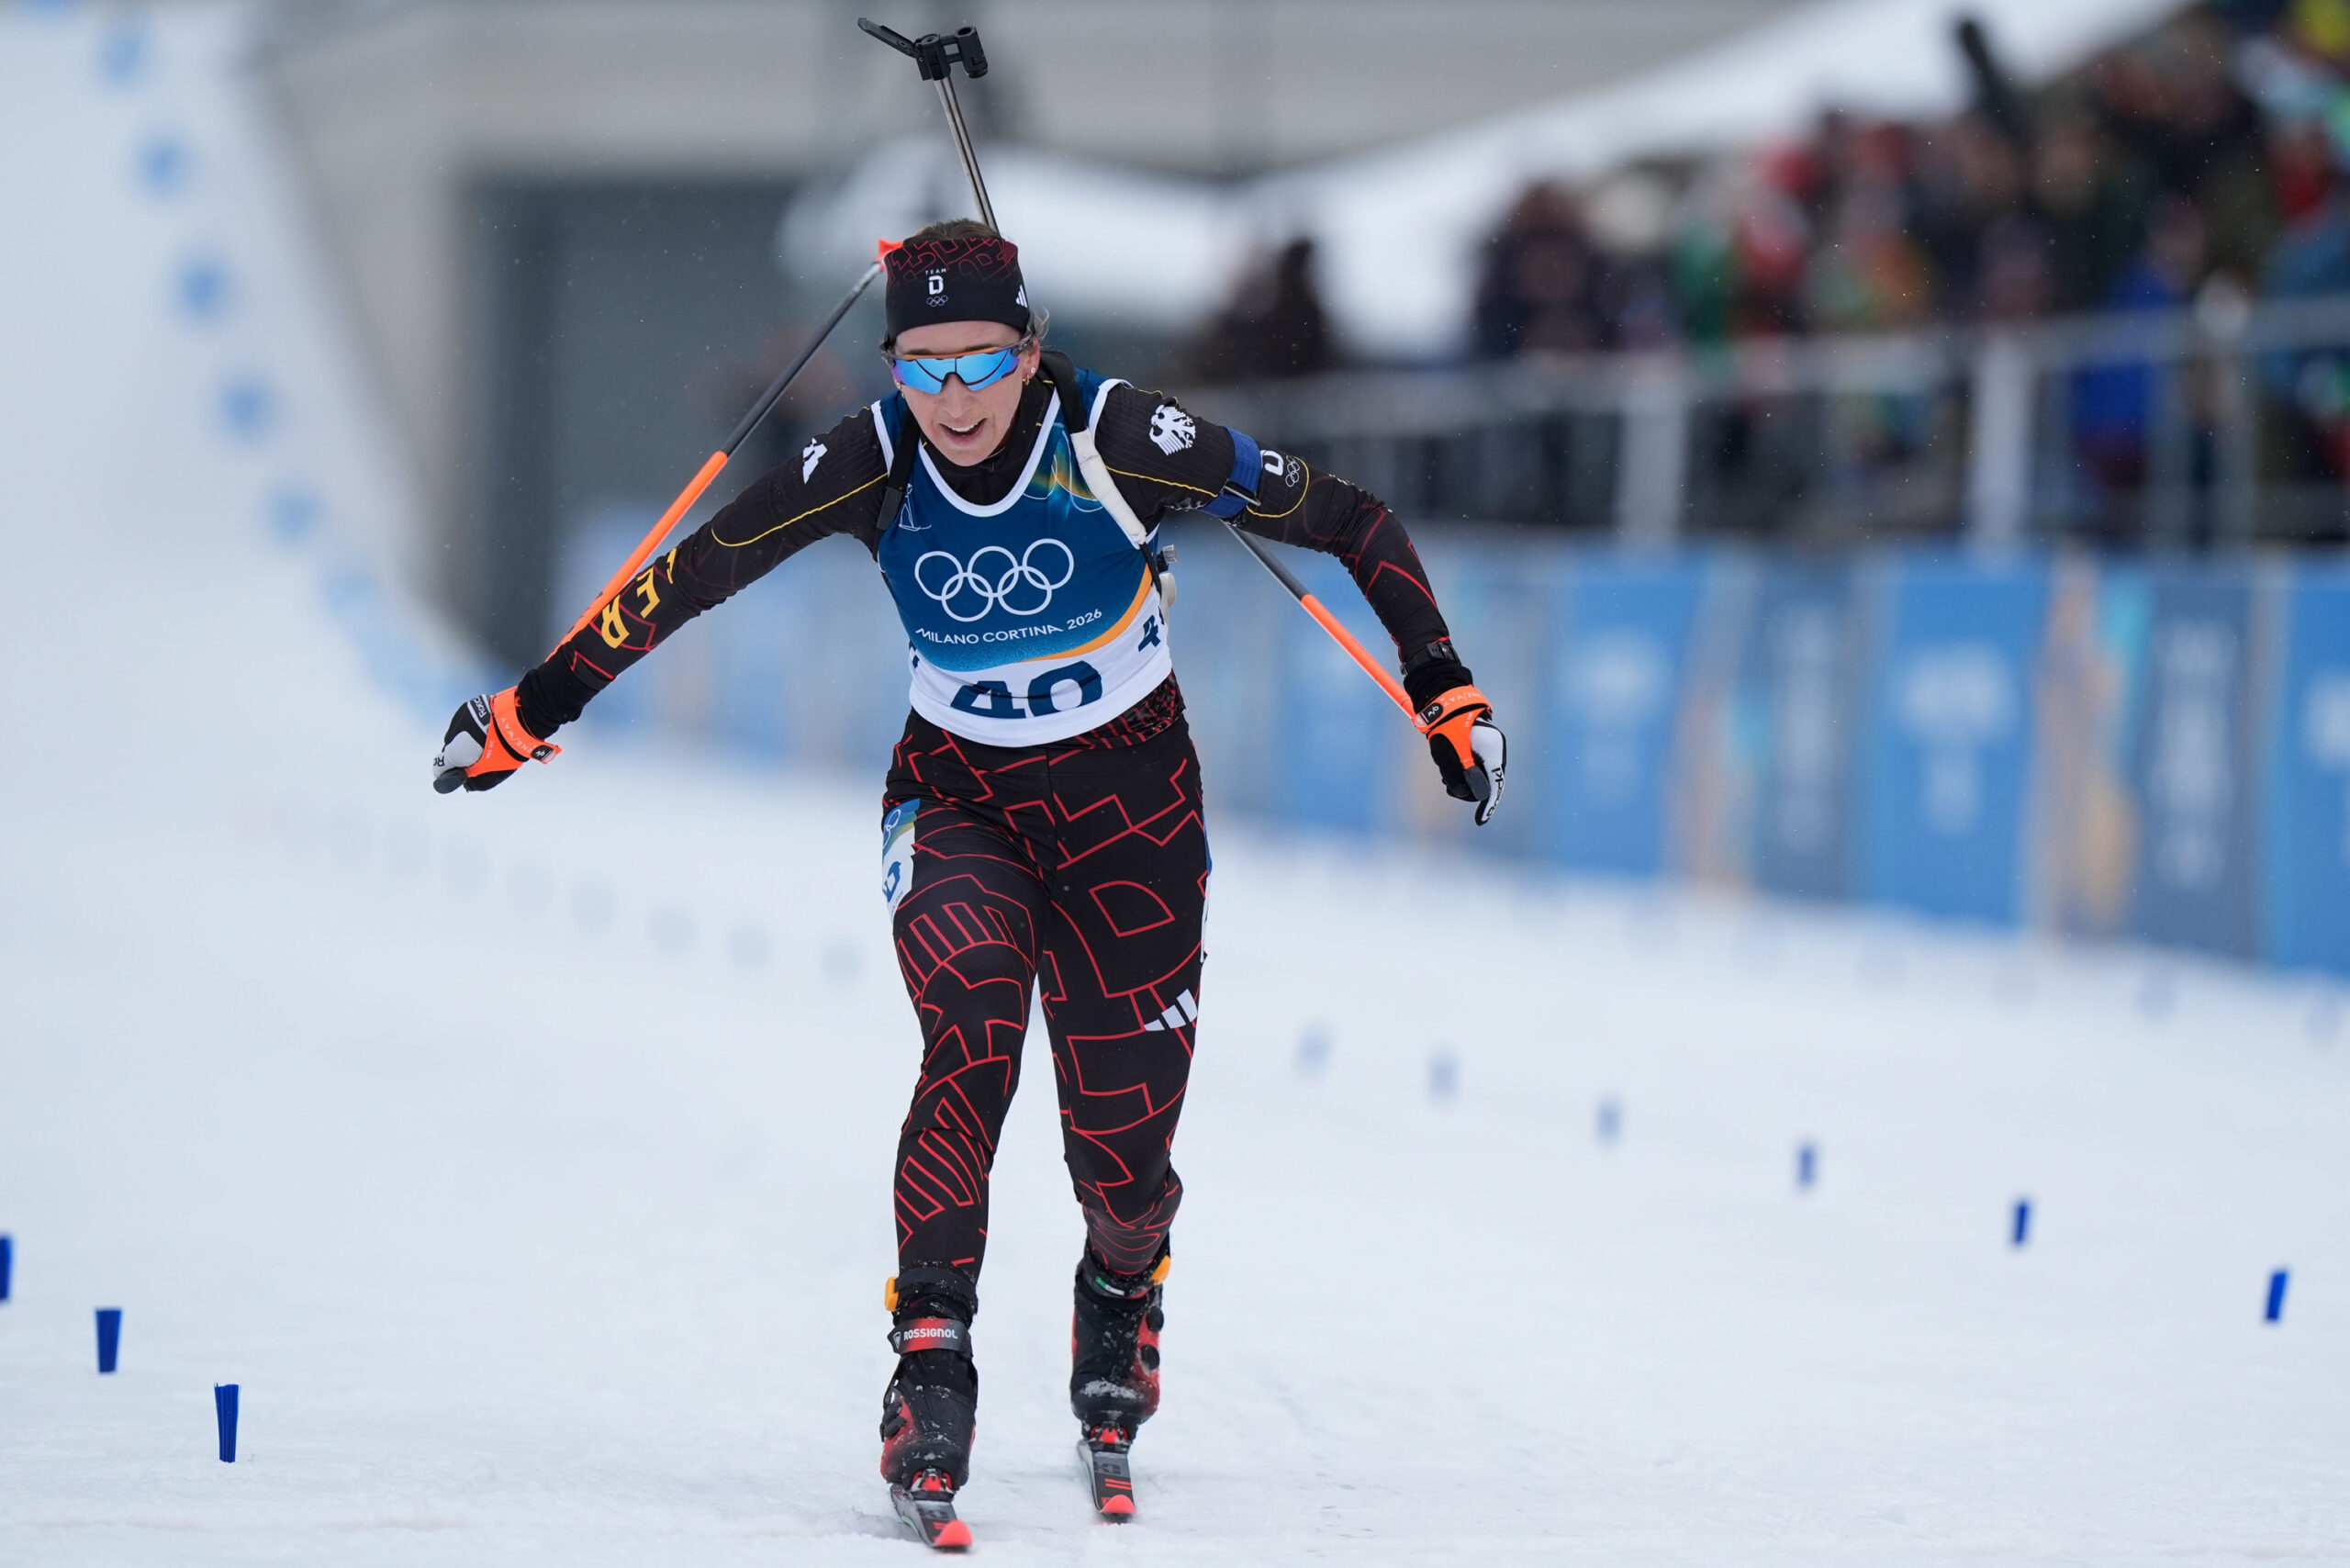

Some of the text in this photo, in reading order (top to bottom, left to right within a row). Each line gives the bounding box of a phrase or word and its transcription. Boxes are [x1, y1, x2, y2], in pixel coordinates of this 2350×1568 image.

[928, 275, 944, 295] D
[915, 609, 1102, 644] MILANO CORTINA 2026
[950, 660, 1103, 720] 40
[903, 1327, 958, 1341] ROSSIGNOL
